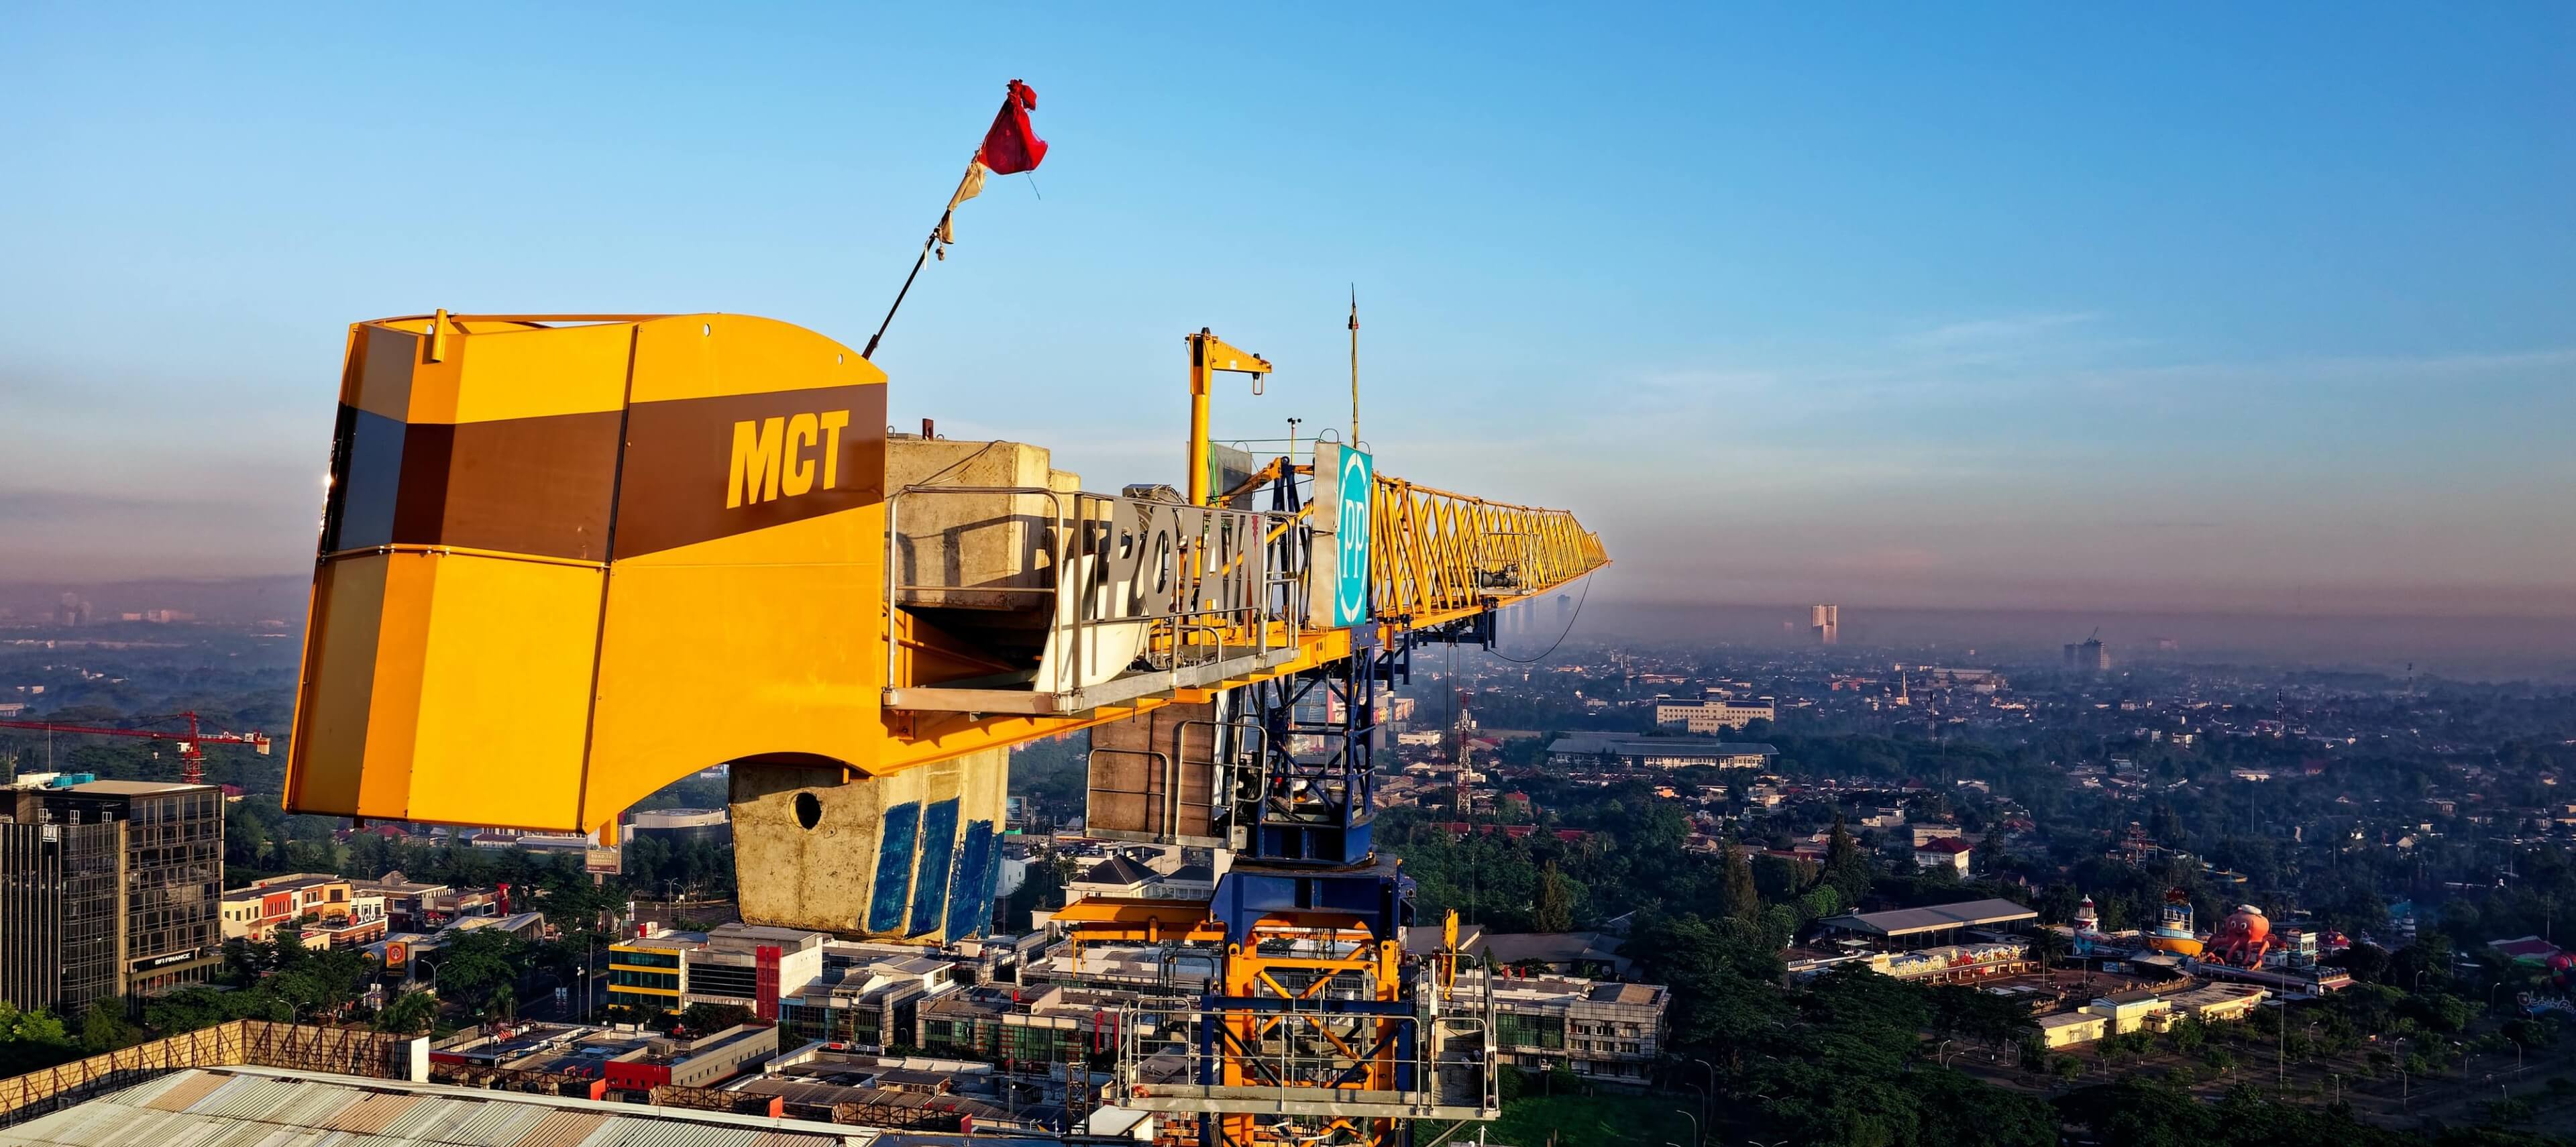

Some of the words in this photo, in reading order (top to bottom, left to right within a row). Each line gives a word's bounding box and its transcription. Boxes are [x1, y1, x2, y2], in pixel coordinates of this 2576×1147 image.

[727, 409, 849, 509] MCT
[1105, 498, 1265, 620] POTAIN
[165, 952, 191, 964] FINANCE
